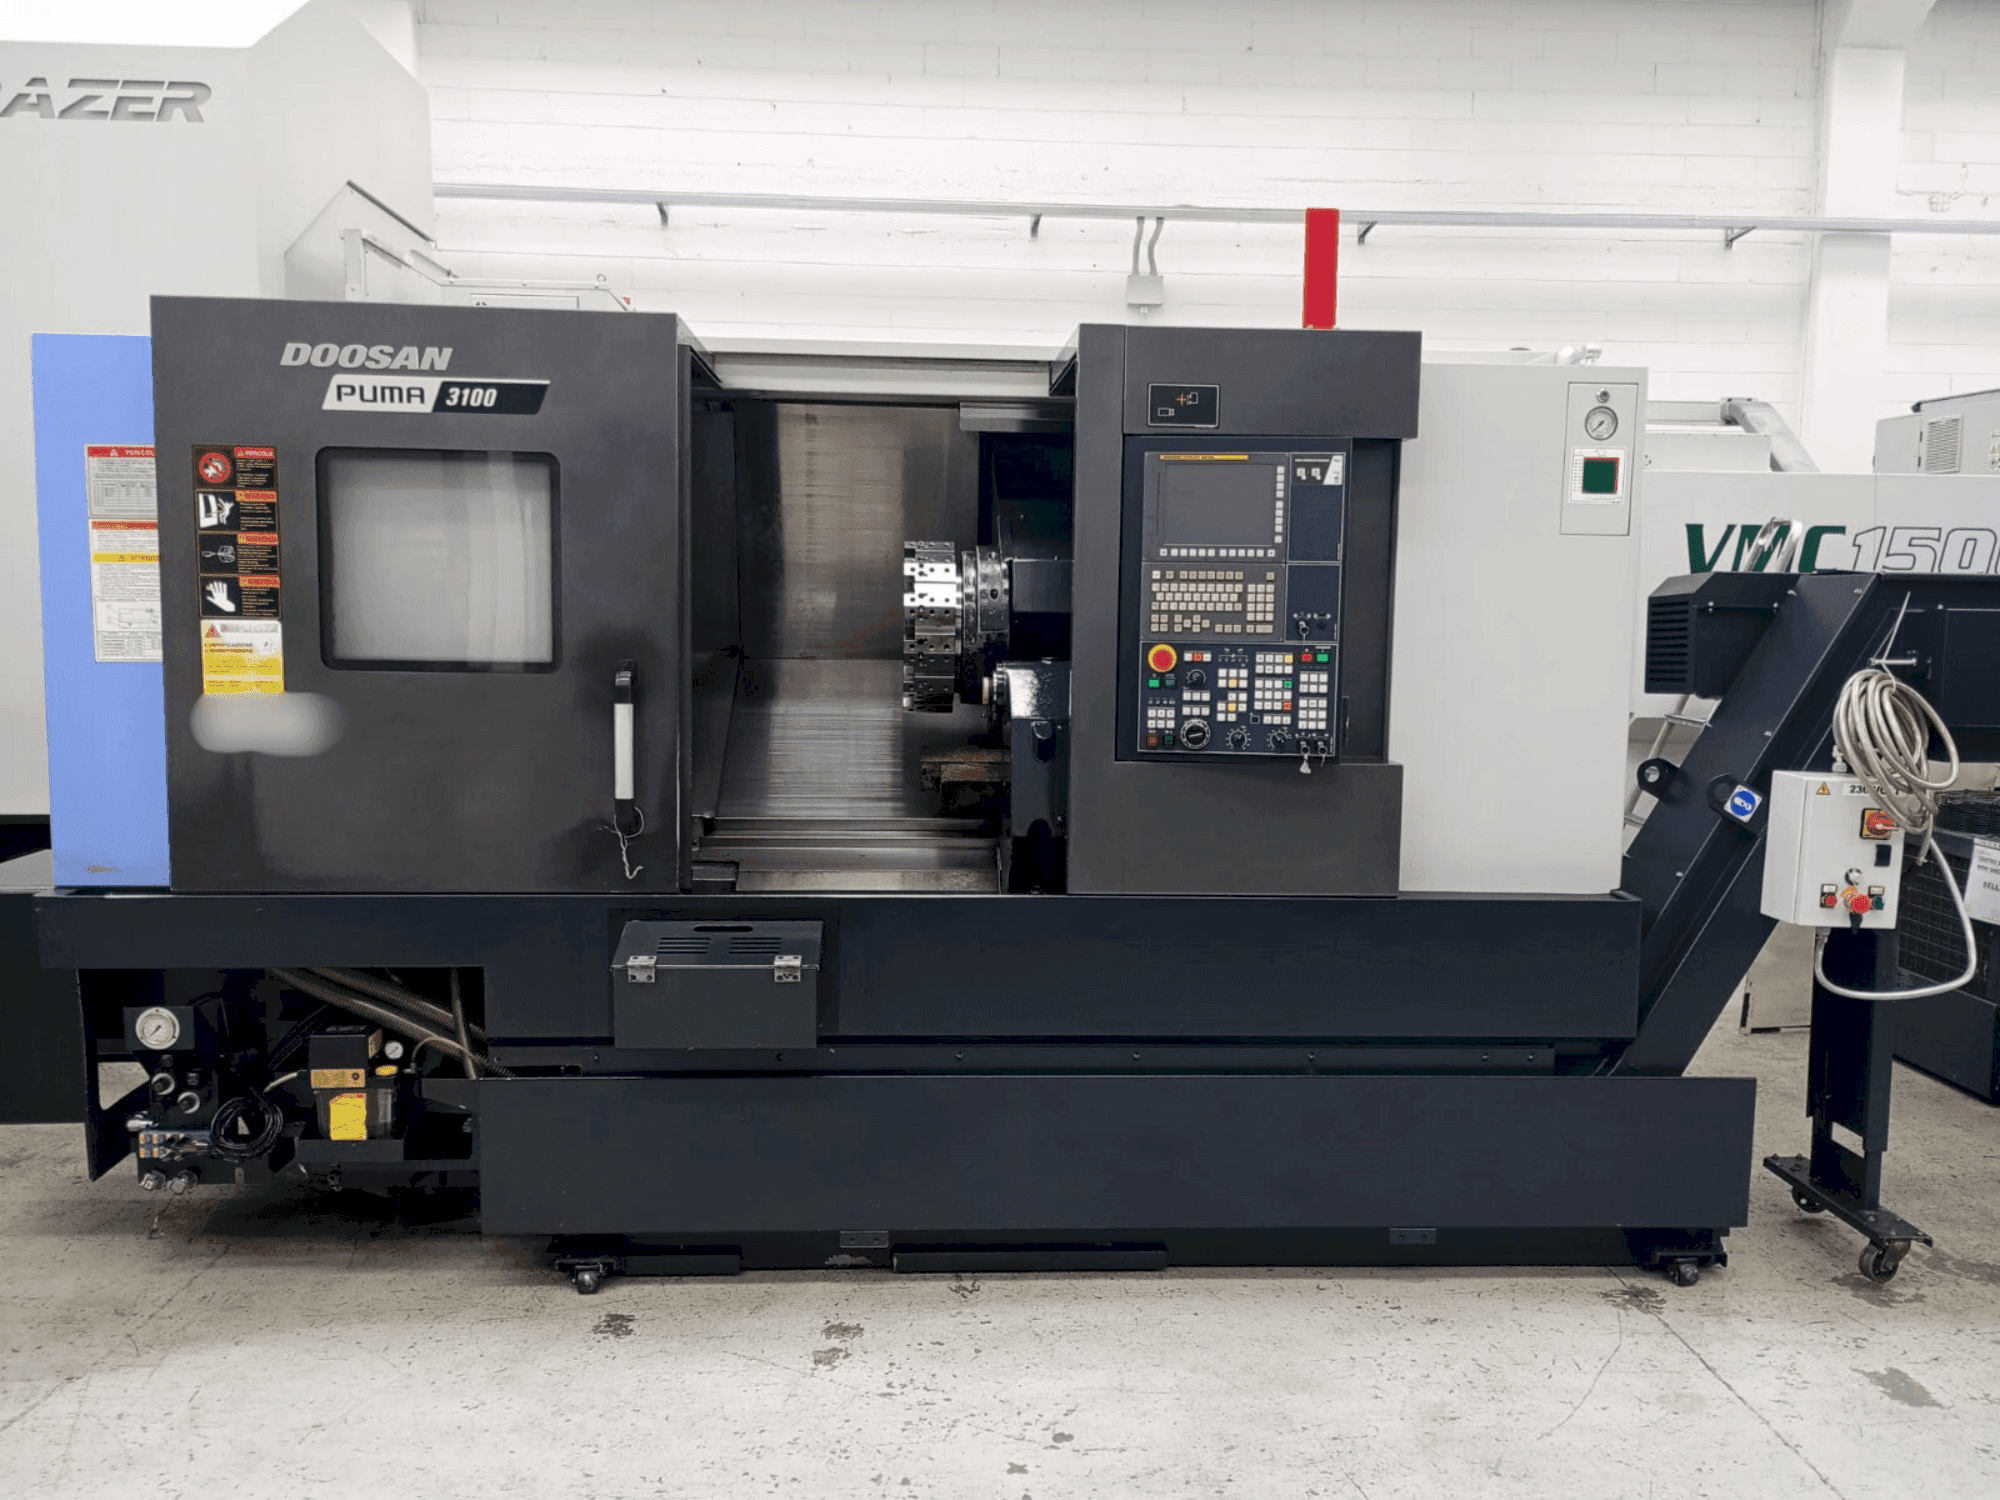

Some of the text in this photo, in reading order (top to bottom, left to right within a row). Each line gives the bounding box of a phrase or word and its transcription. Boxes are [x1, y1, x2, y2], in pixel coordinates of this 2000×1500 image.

[0, 77, 212, 123] AZER
[280, 342, 453, 371] DOOSAN
[336, 384, 498, 408] PUMA 3100
